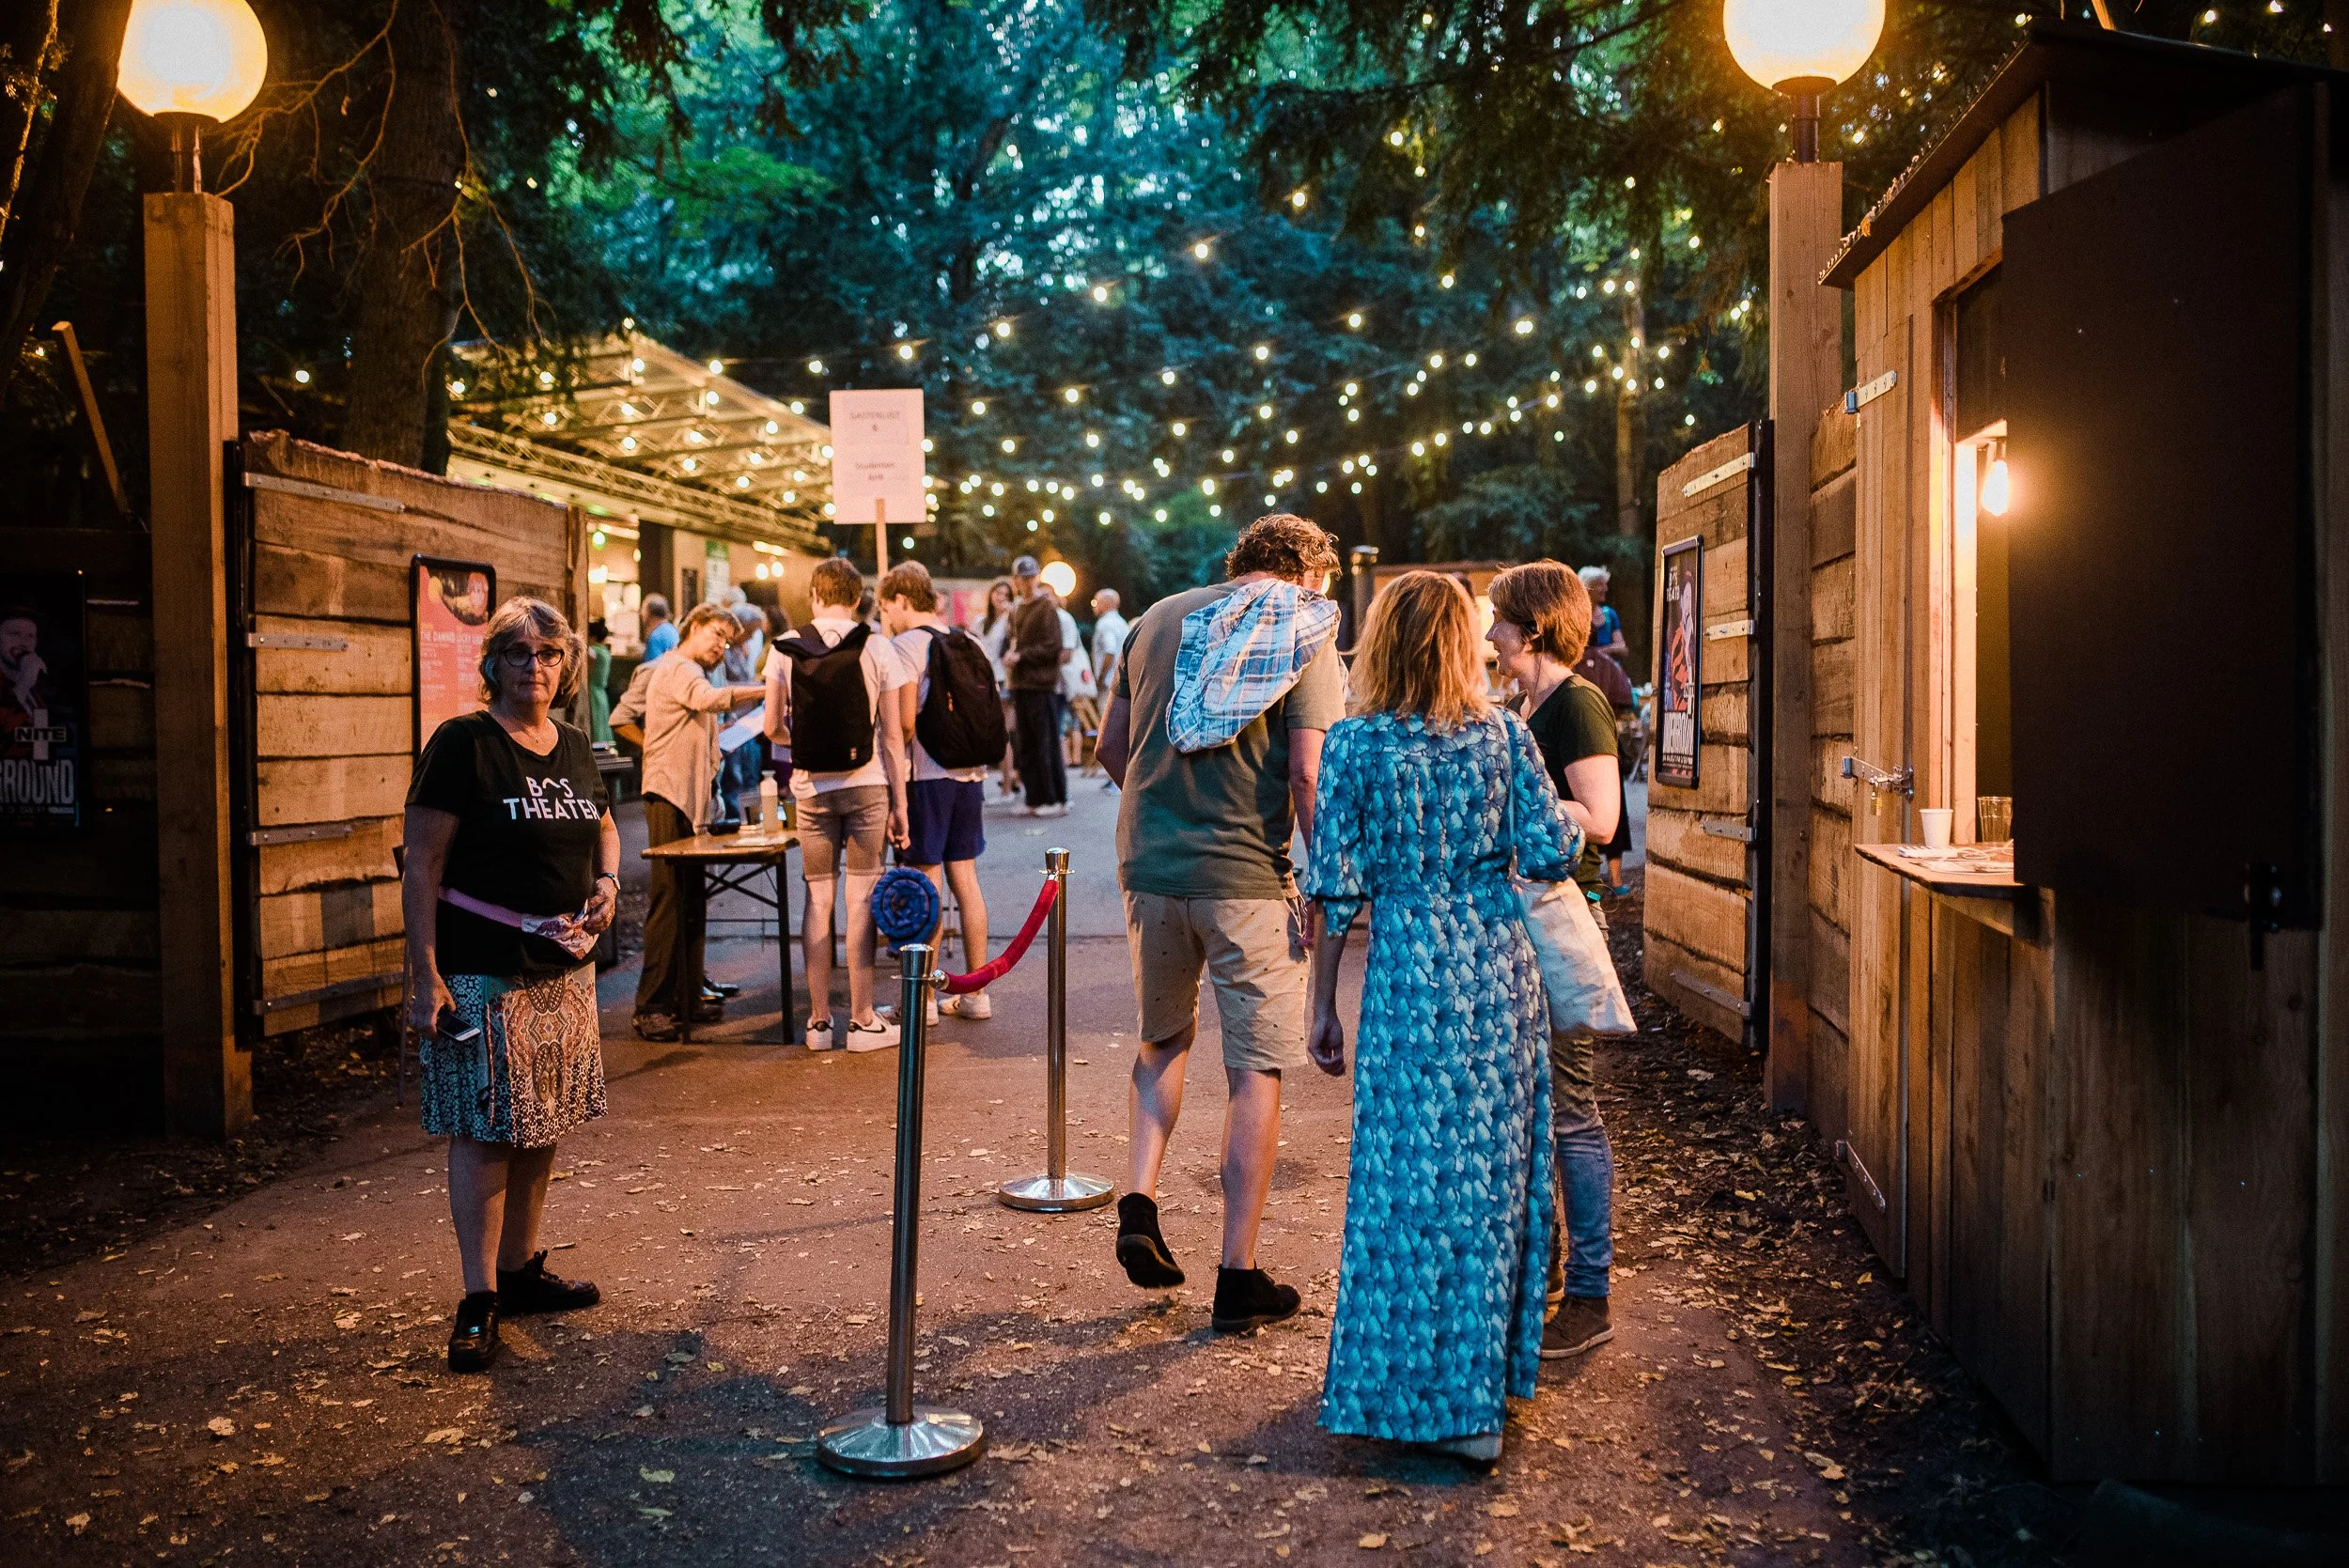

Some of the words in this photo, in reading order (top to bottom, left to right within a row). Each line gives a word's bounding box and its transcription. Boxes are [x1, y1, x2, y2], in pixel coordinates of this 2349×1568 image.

[16, 728, 67, 741] NITE
[0, 758, 74, 804] ROUND
[503, 797, 600, 820] THEATER
